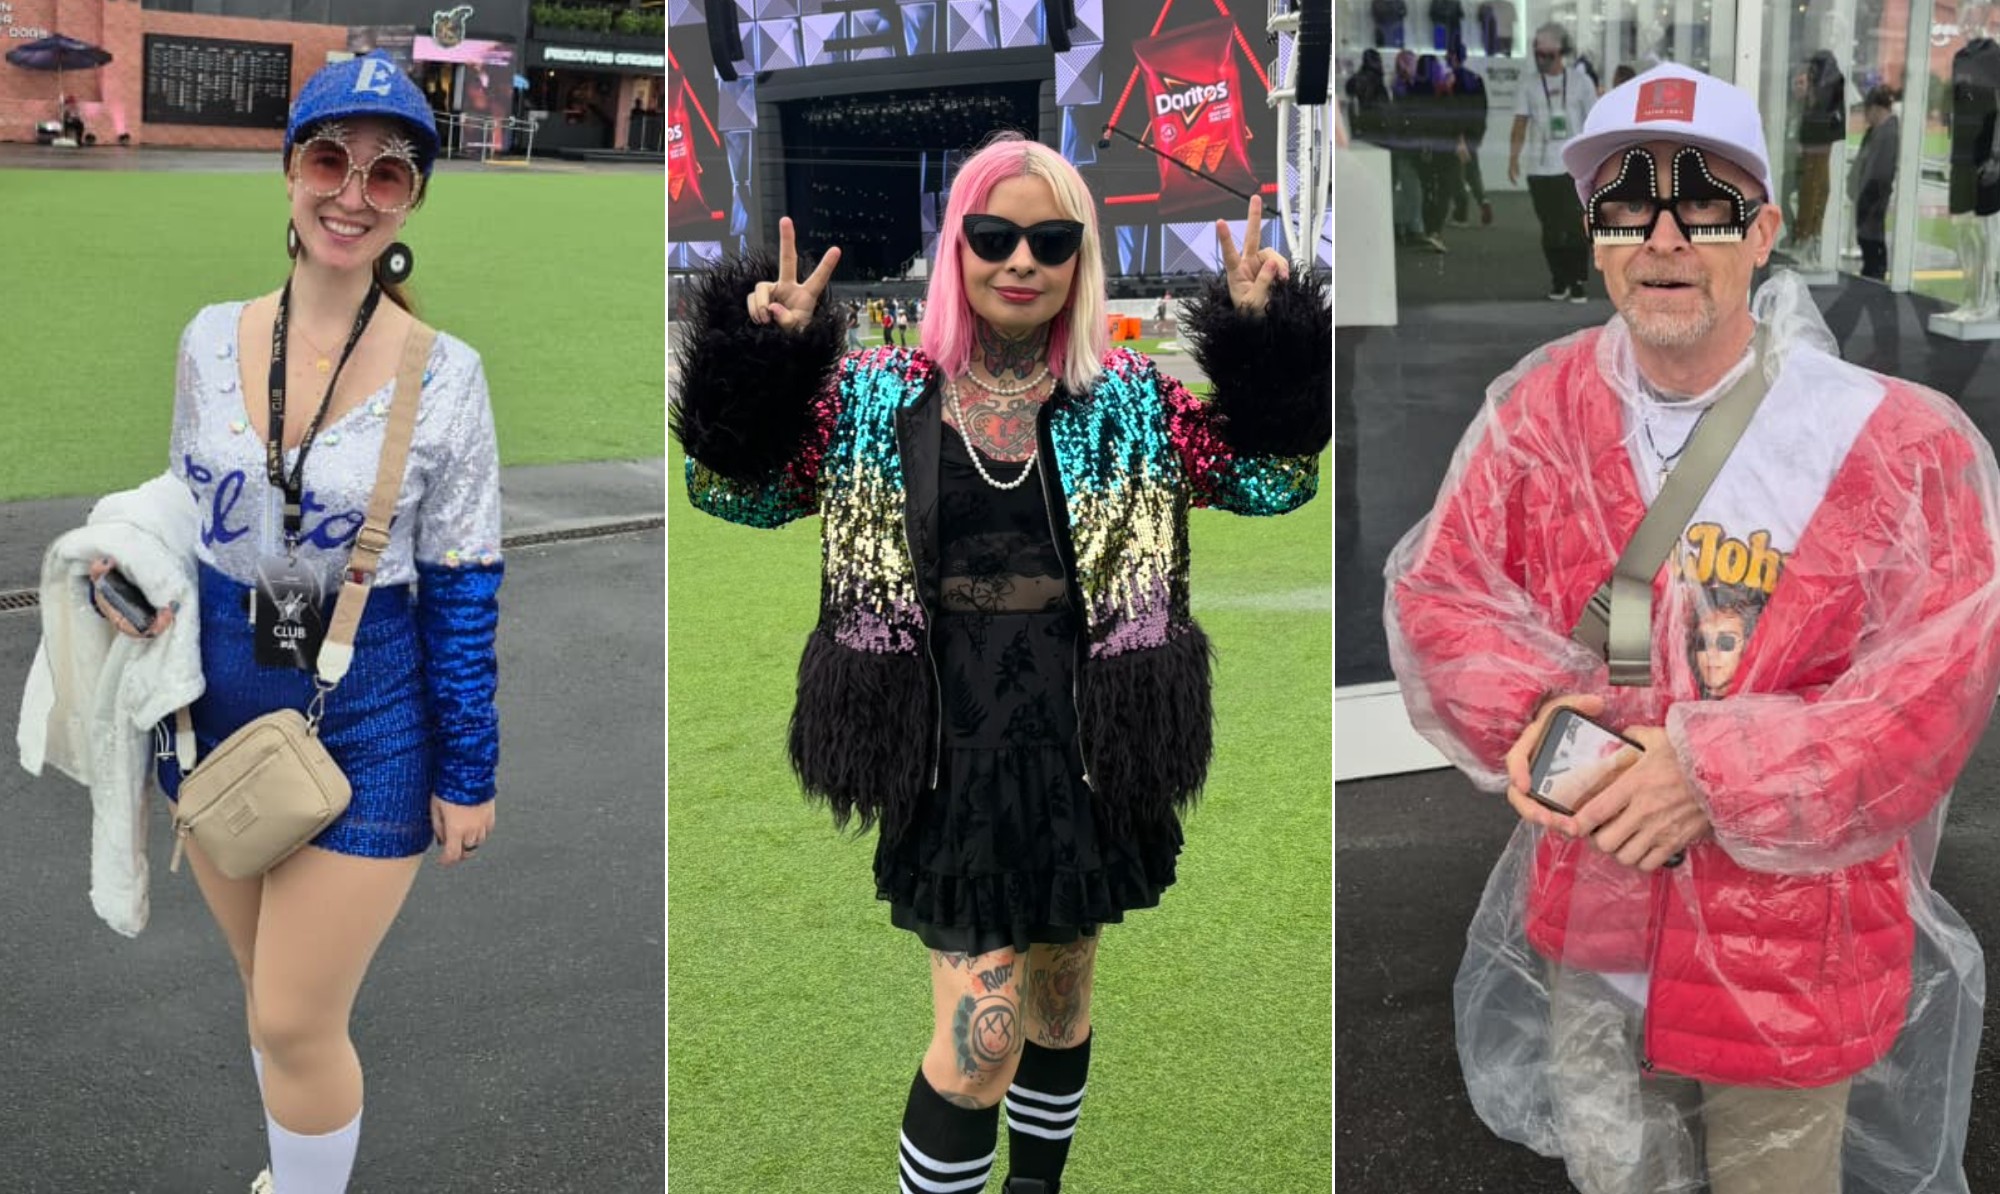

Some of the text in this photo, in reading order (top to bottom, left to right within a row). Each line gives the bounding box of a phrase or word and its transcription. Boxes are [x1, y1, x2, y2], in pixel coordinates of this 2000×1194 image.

[352, 57, 396, 97] E
[1155, 80, 1229, 115] Doritos
[1683, 521, 1791, 595] Joh
[273, 625, 307, 639] CLUB
